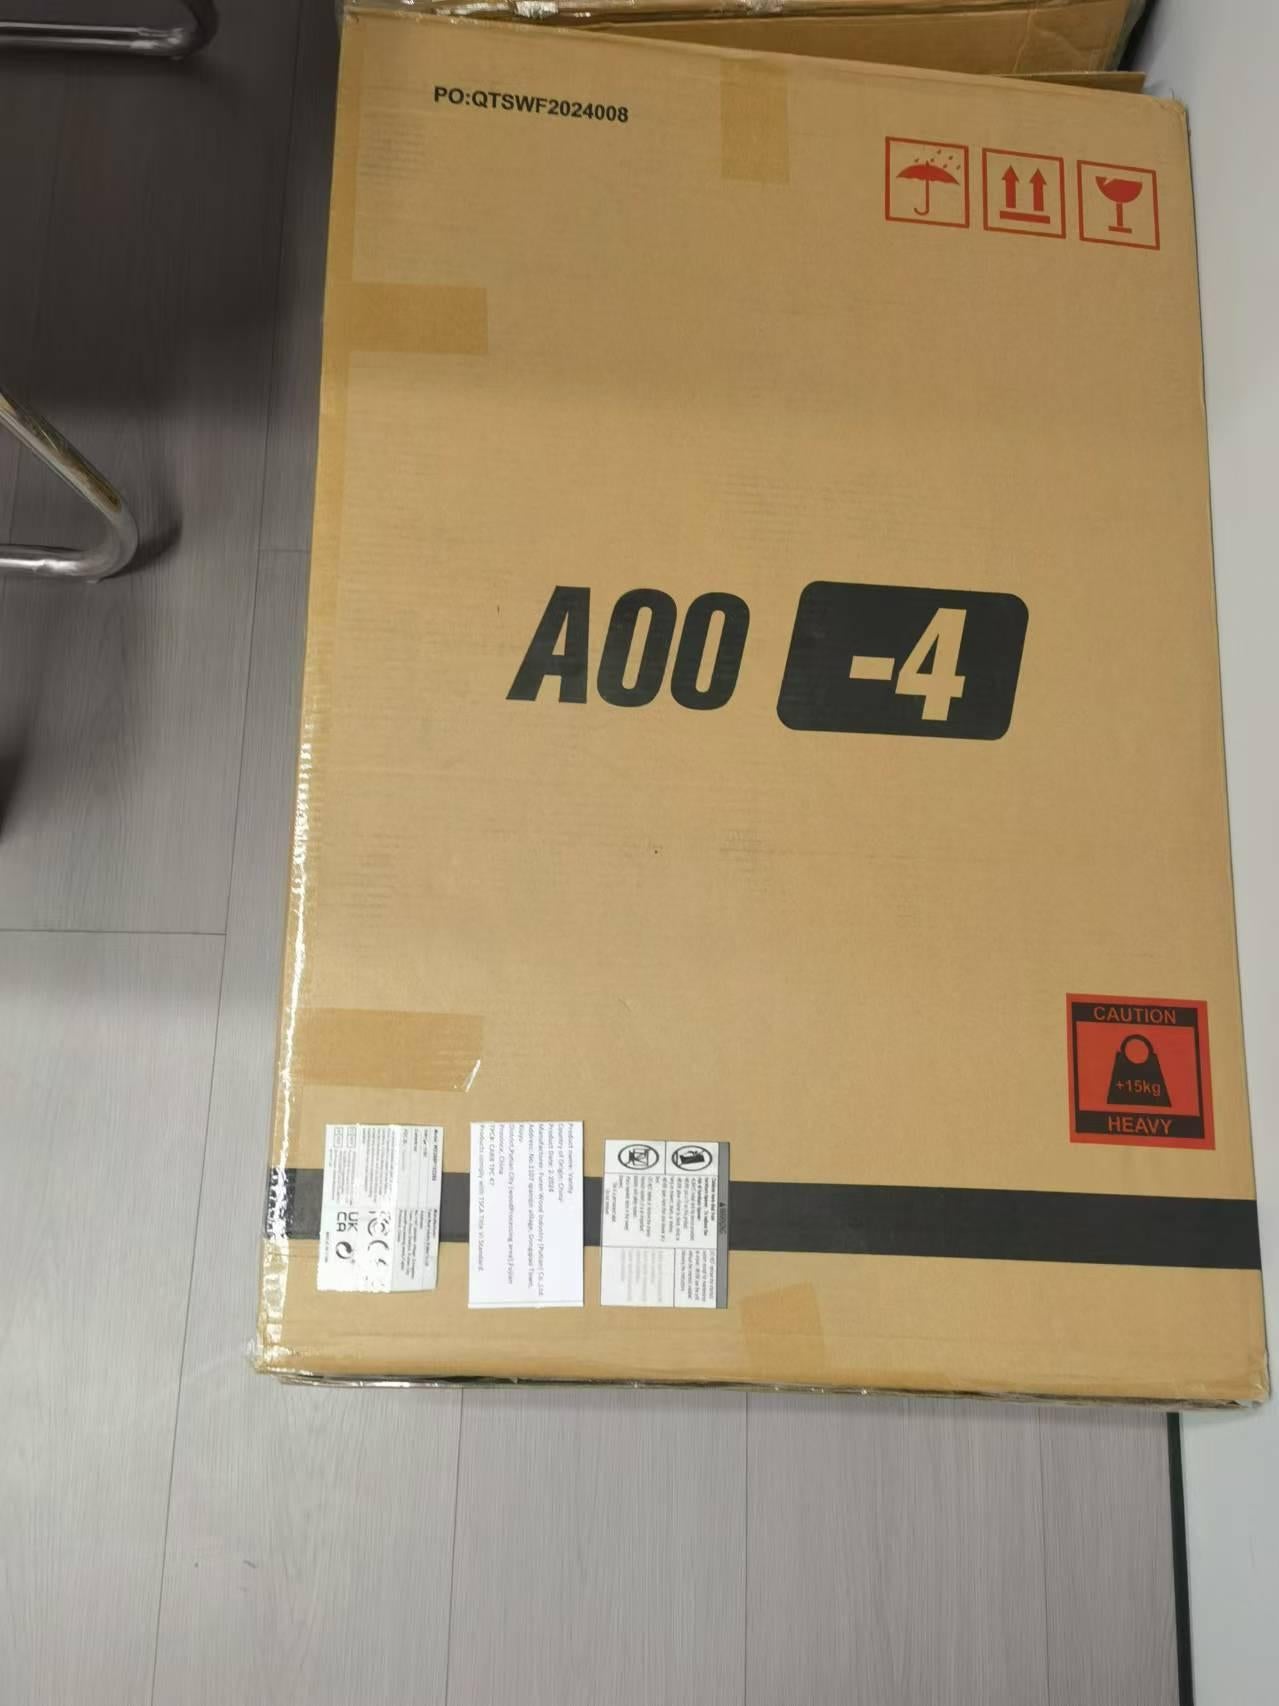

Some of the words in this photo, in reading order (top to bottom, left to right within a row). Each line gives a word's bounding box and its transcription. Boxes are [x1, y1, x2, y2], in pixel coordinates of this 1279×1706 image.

[434, 86, 629, 123] PO:QTSWF2024008
[849, 608, 967, 721] -4
[1094, 1007, 1176, 1024] CAUTION
[1116, 1080, 1160, 1096] +15kg
[1108, 1116, 1172, 1135] HEAVY
